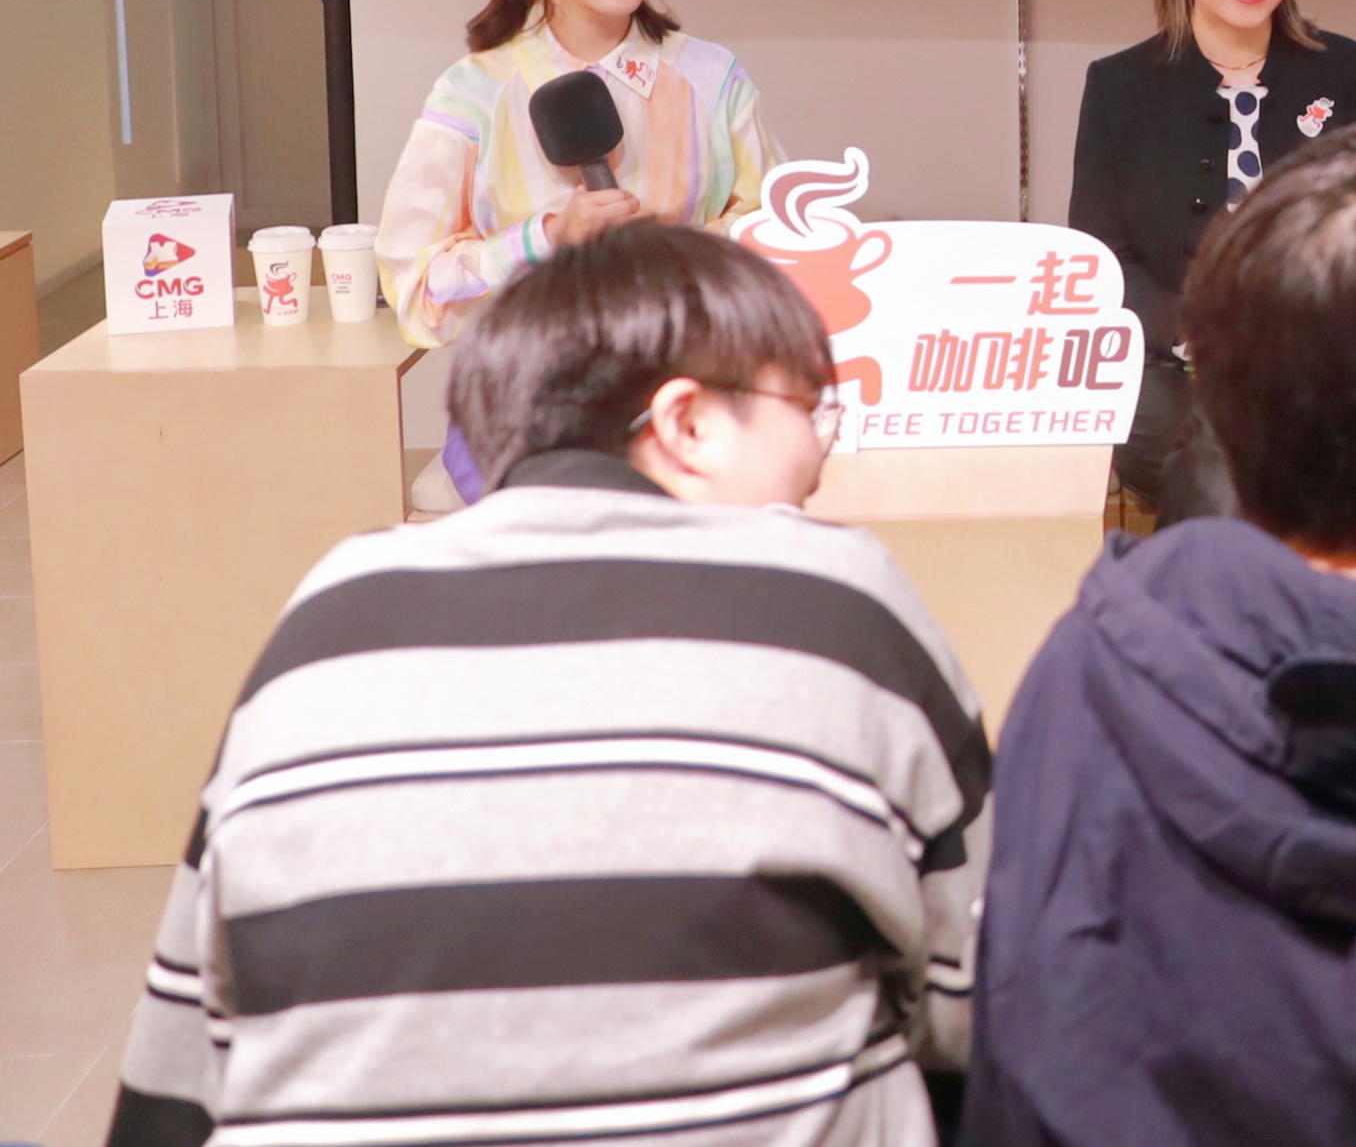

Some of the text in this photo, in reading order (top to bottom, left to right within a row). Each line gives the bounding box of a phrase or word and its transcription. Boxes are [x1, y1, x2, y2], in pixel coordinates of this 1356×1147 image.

[135, 276, 204, 299] CMG
[951, 252, 1099, 315] 一起
[148, 299, 194, 320] 上海
[909, 326, 1132, 392] 咖啡吧
[940, 410, 1116, 434] TOGETHER
